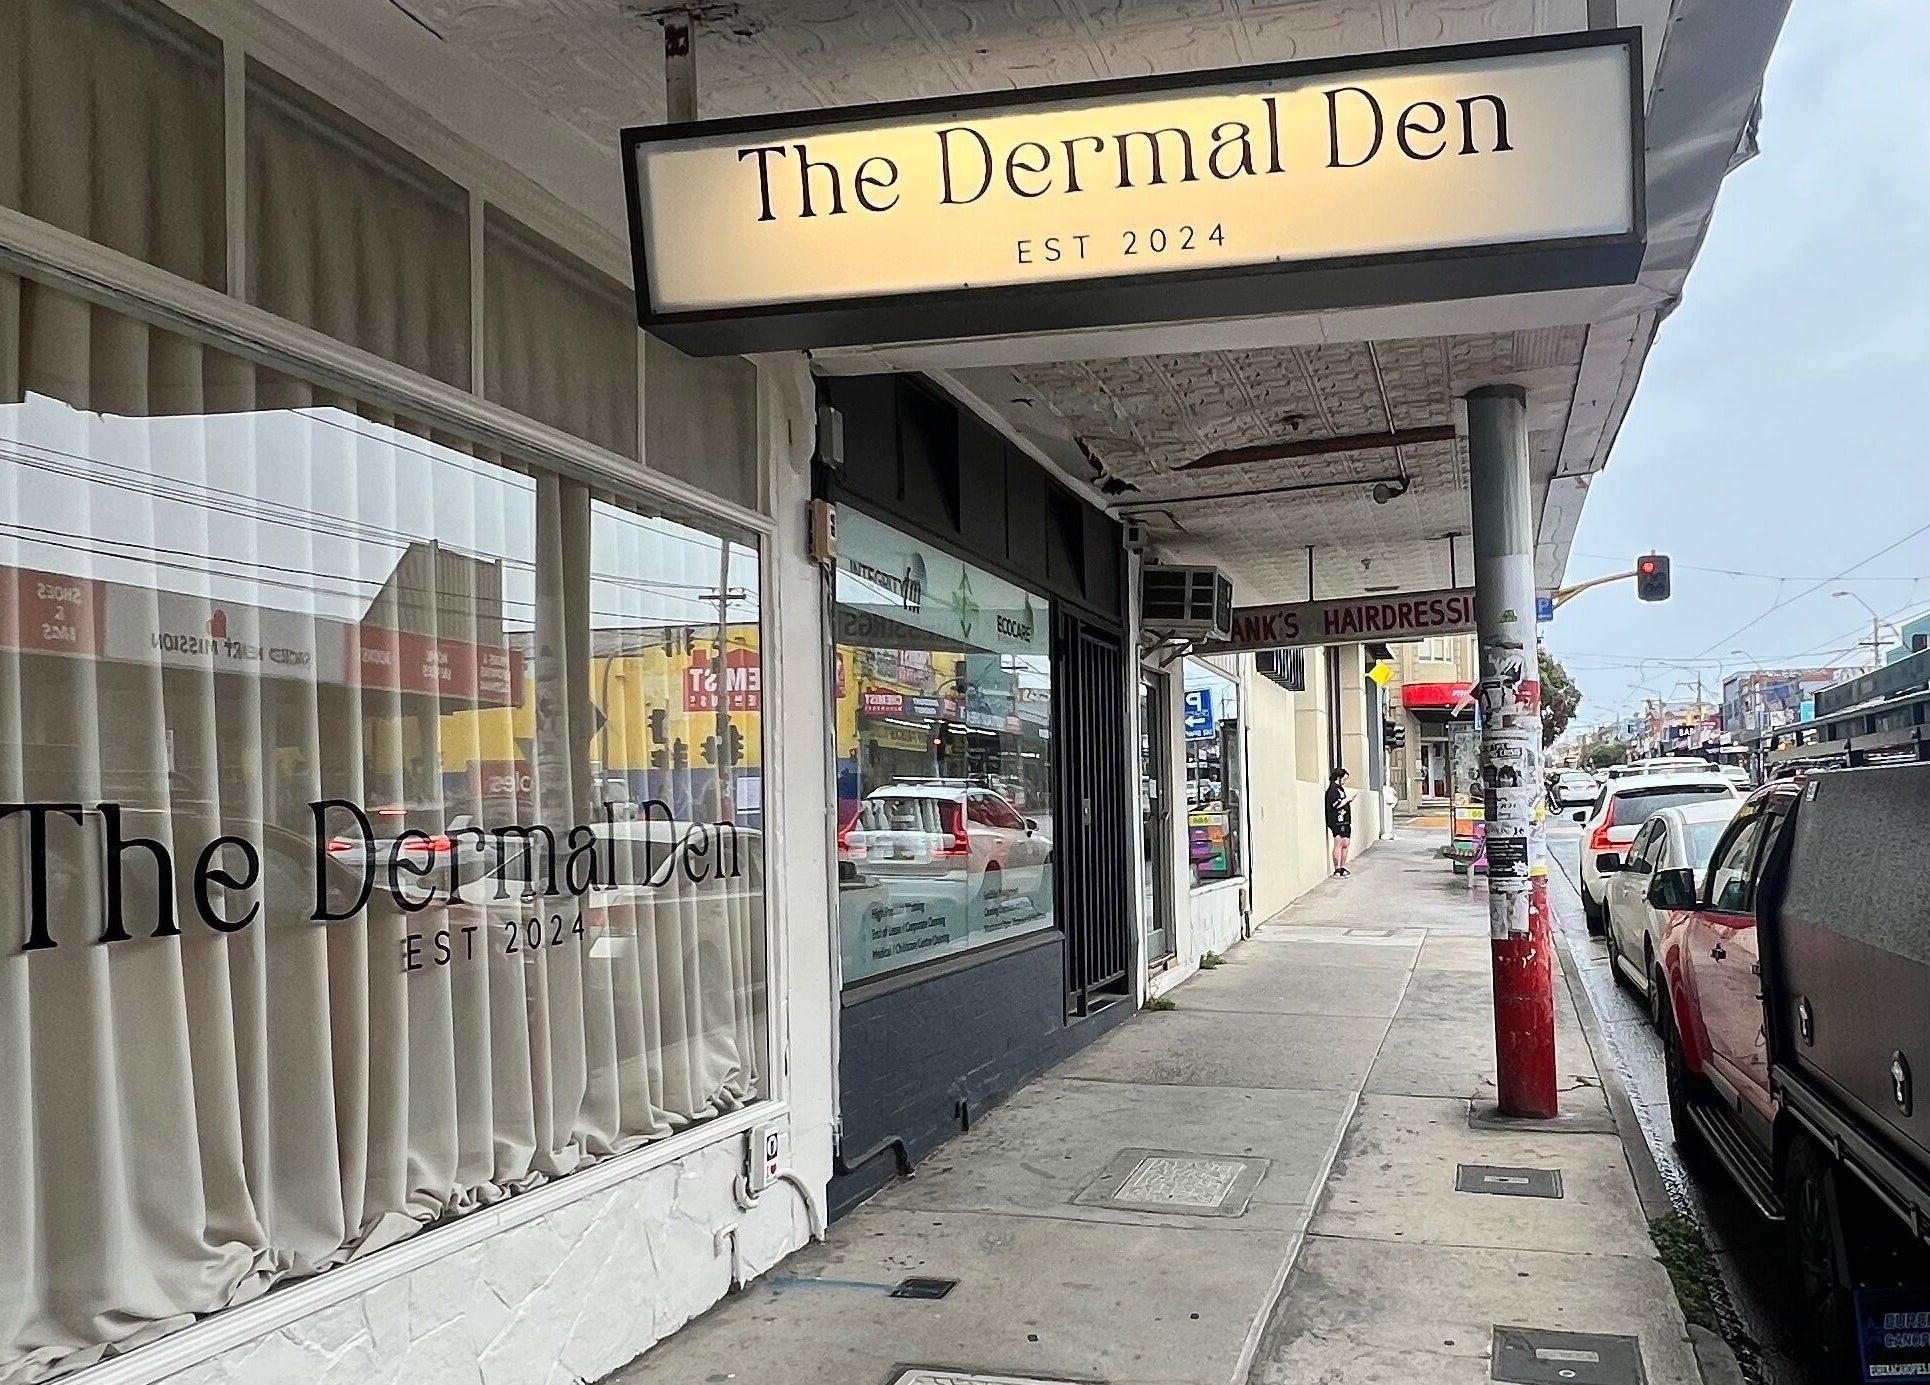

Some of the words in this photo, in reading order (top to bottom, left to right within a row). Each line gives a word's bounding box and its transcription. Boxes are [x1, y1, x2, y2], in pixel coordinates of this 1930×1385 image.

[738, 146, 900, 222] The
[937, 98, 1285, 206] Dermal
[1323, 85, 1513, 170] Den
[1017, 236, 1093, 264] EST
[1122, 223, 1229, 257] 2024
[996, 614, 1032, 643] ECOCARE
[1232, 611, 1300, 642] ANK'S
[1323, 597, 1477, 636] HAIRDRESSI
[0, 803, 261, 951] The
[308, 799, 618, 922] Dermal
[642, 799, 742, 887] Den
[405, 932, 477, 972] EST
[505, 914, 587, 957] 2024
[1884, 1332, 1930, 1348] CANOP
